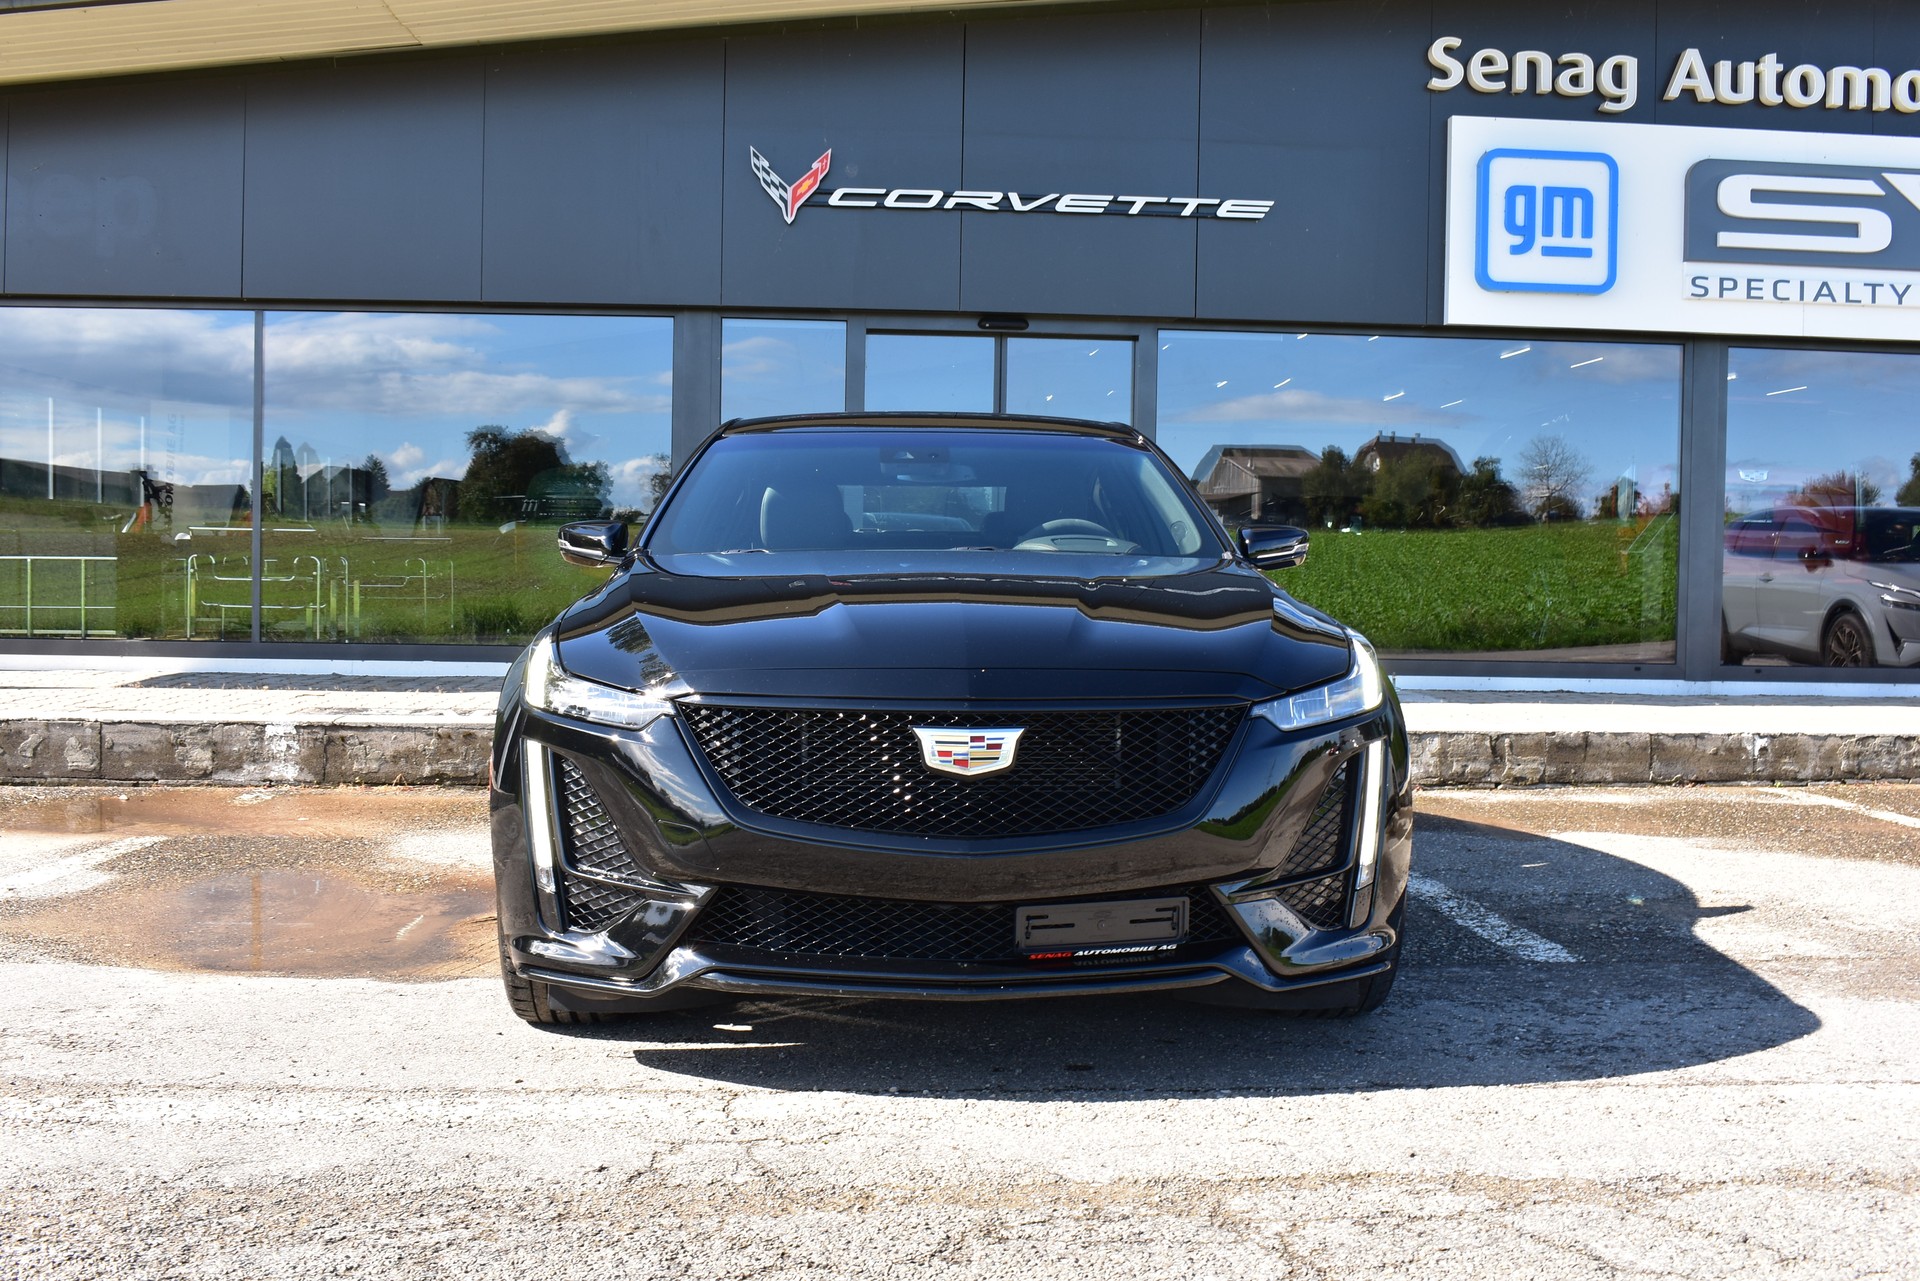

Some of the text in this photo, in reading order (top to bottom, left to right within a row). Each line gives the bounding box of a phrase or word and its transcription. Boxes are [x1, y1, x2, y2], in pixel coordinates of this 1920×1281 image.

[1427, 36, 1638, 113] Senag
[828, 187, 1275, 219] CORVETTE
[1504, 185, 1594, 257] gm
[1691, 276, 1912, 305] SPECIALTY
[1030, 952, 1072, 960] SENAG
[1075, 945, 1157, 957] AUTOMOBILE
